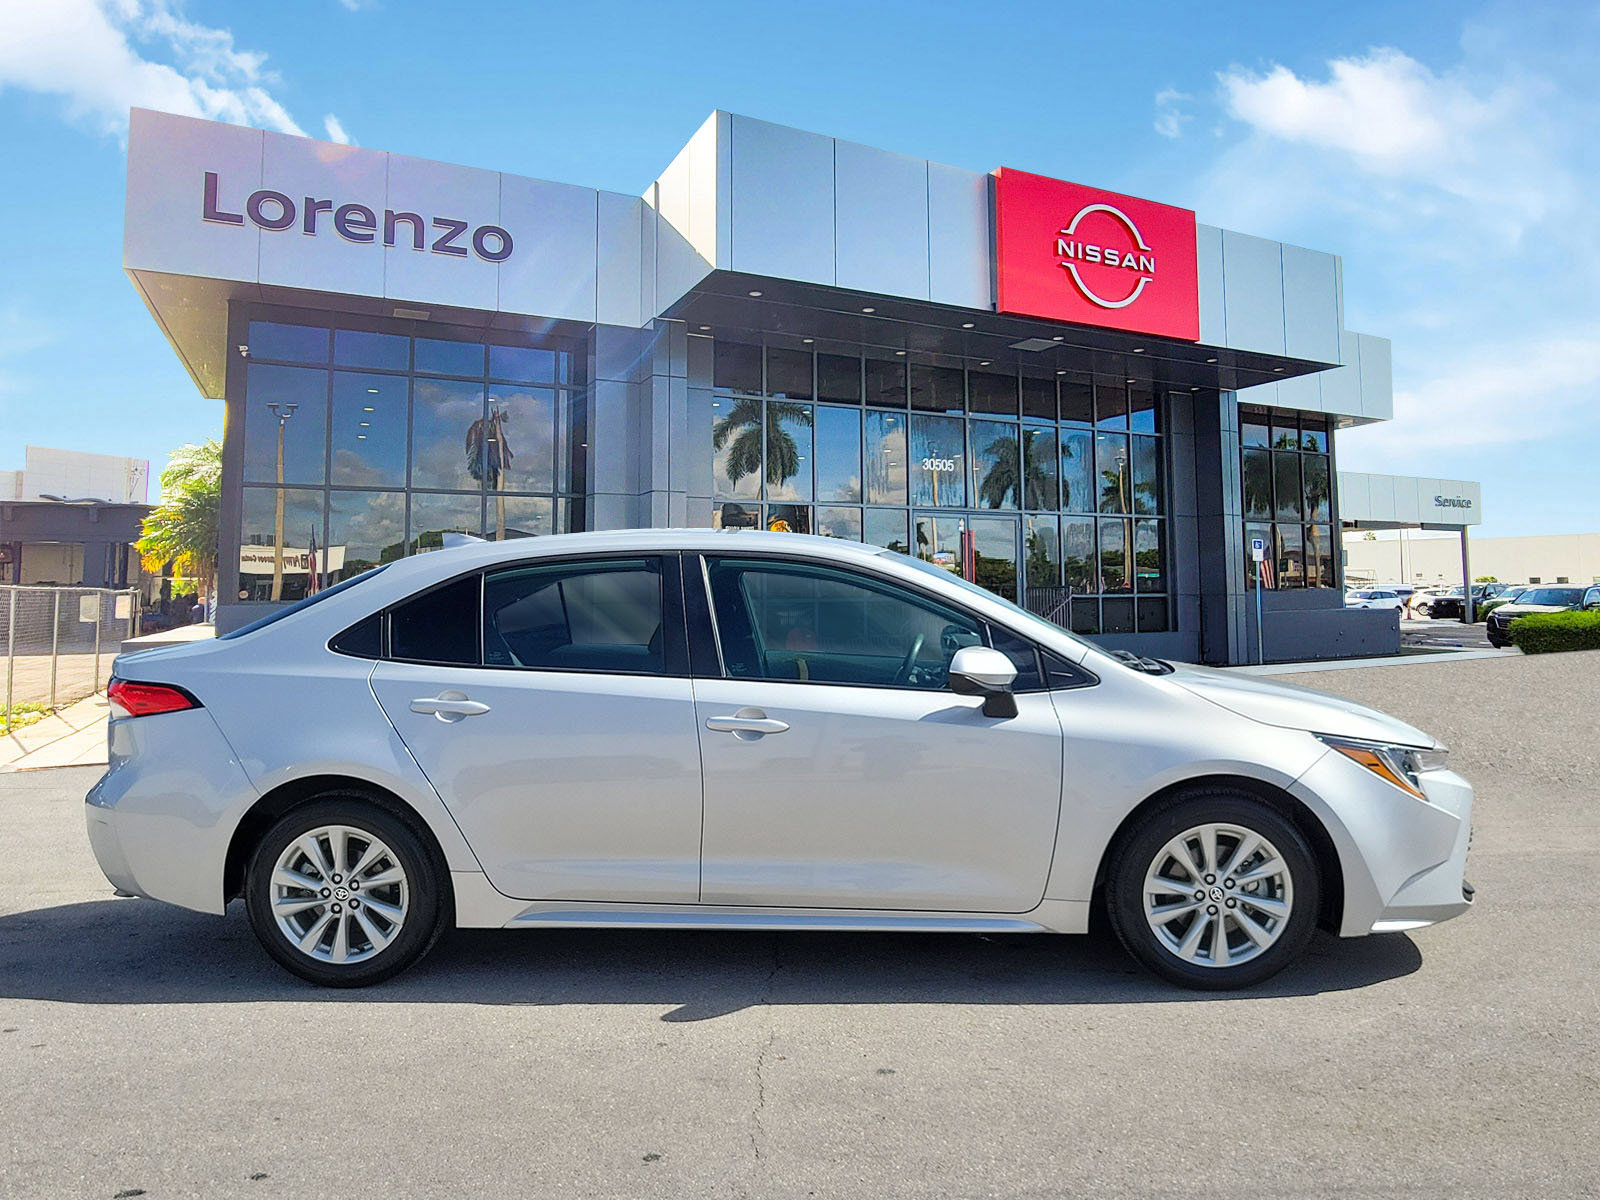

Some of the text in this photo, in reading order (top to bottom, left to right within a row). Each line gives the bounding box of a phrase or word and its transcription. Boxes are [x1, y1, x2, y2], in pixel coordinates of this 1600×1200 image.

[202, 171, 515, 262] Lorenzo
[1057, 238, 1155, 273] NISSAN
[922, 458, 954, 471] 30505
[1434, 495, 1472, 509] Service
